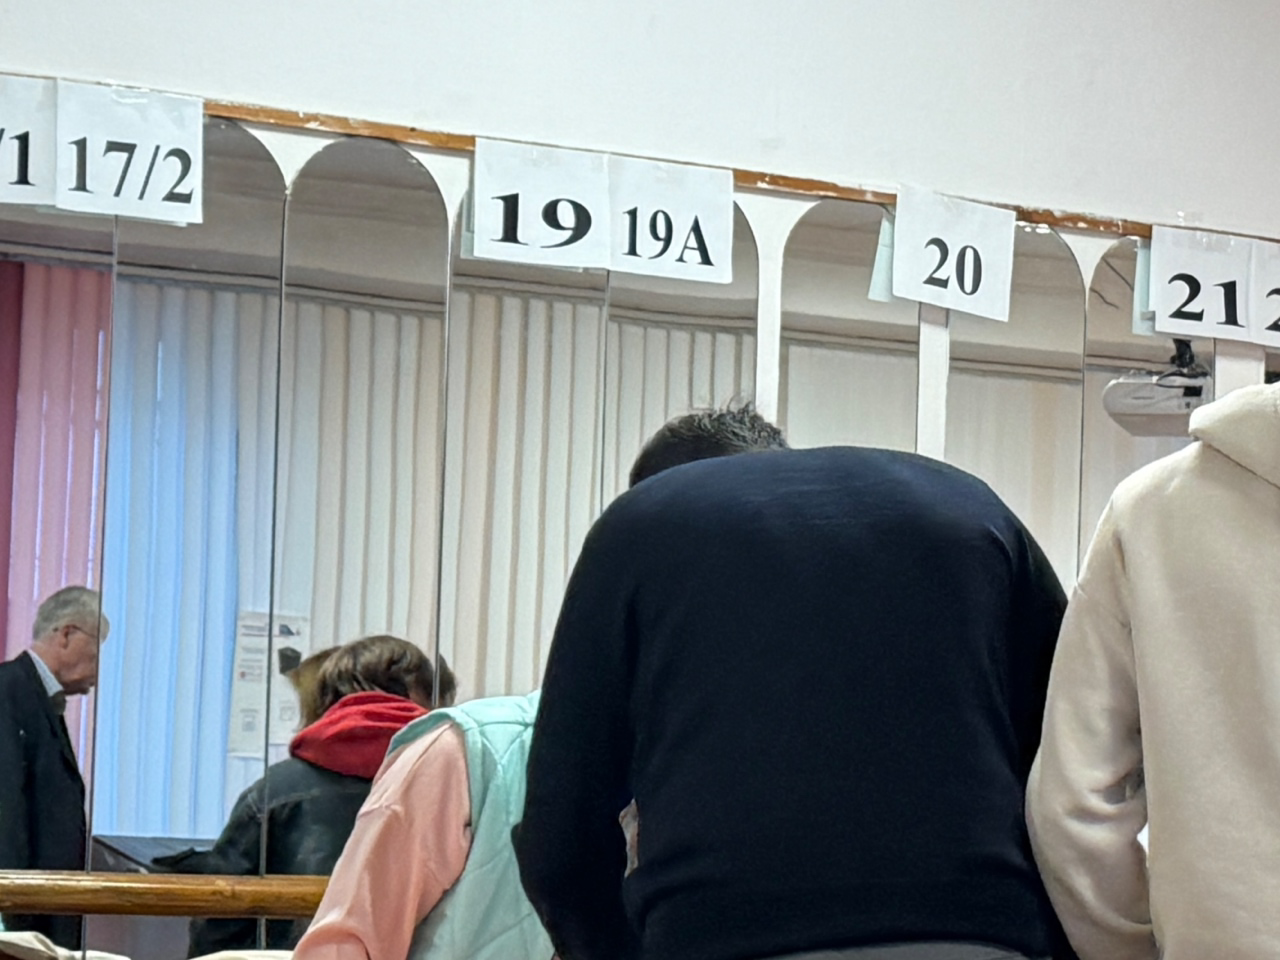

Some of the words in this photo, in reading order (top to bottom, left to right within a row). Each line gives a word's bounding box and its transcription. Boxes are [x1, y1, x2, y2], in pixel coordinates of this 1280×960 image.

[68, 136, 194, 204] 17/2
[490, 192, 592, 249] 19
[622, 206, 715, 267] 19А
[922, 236, 983, 296] 20
[1168, 272, 1246, 328] 21
